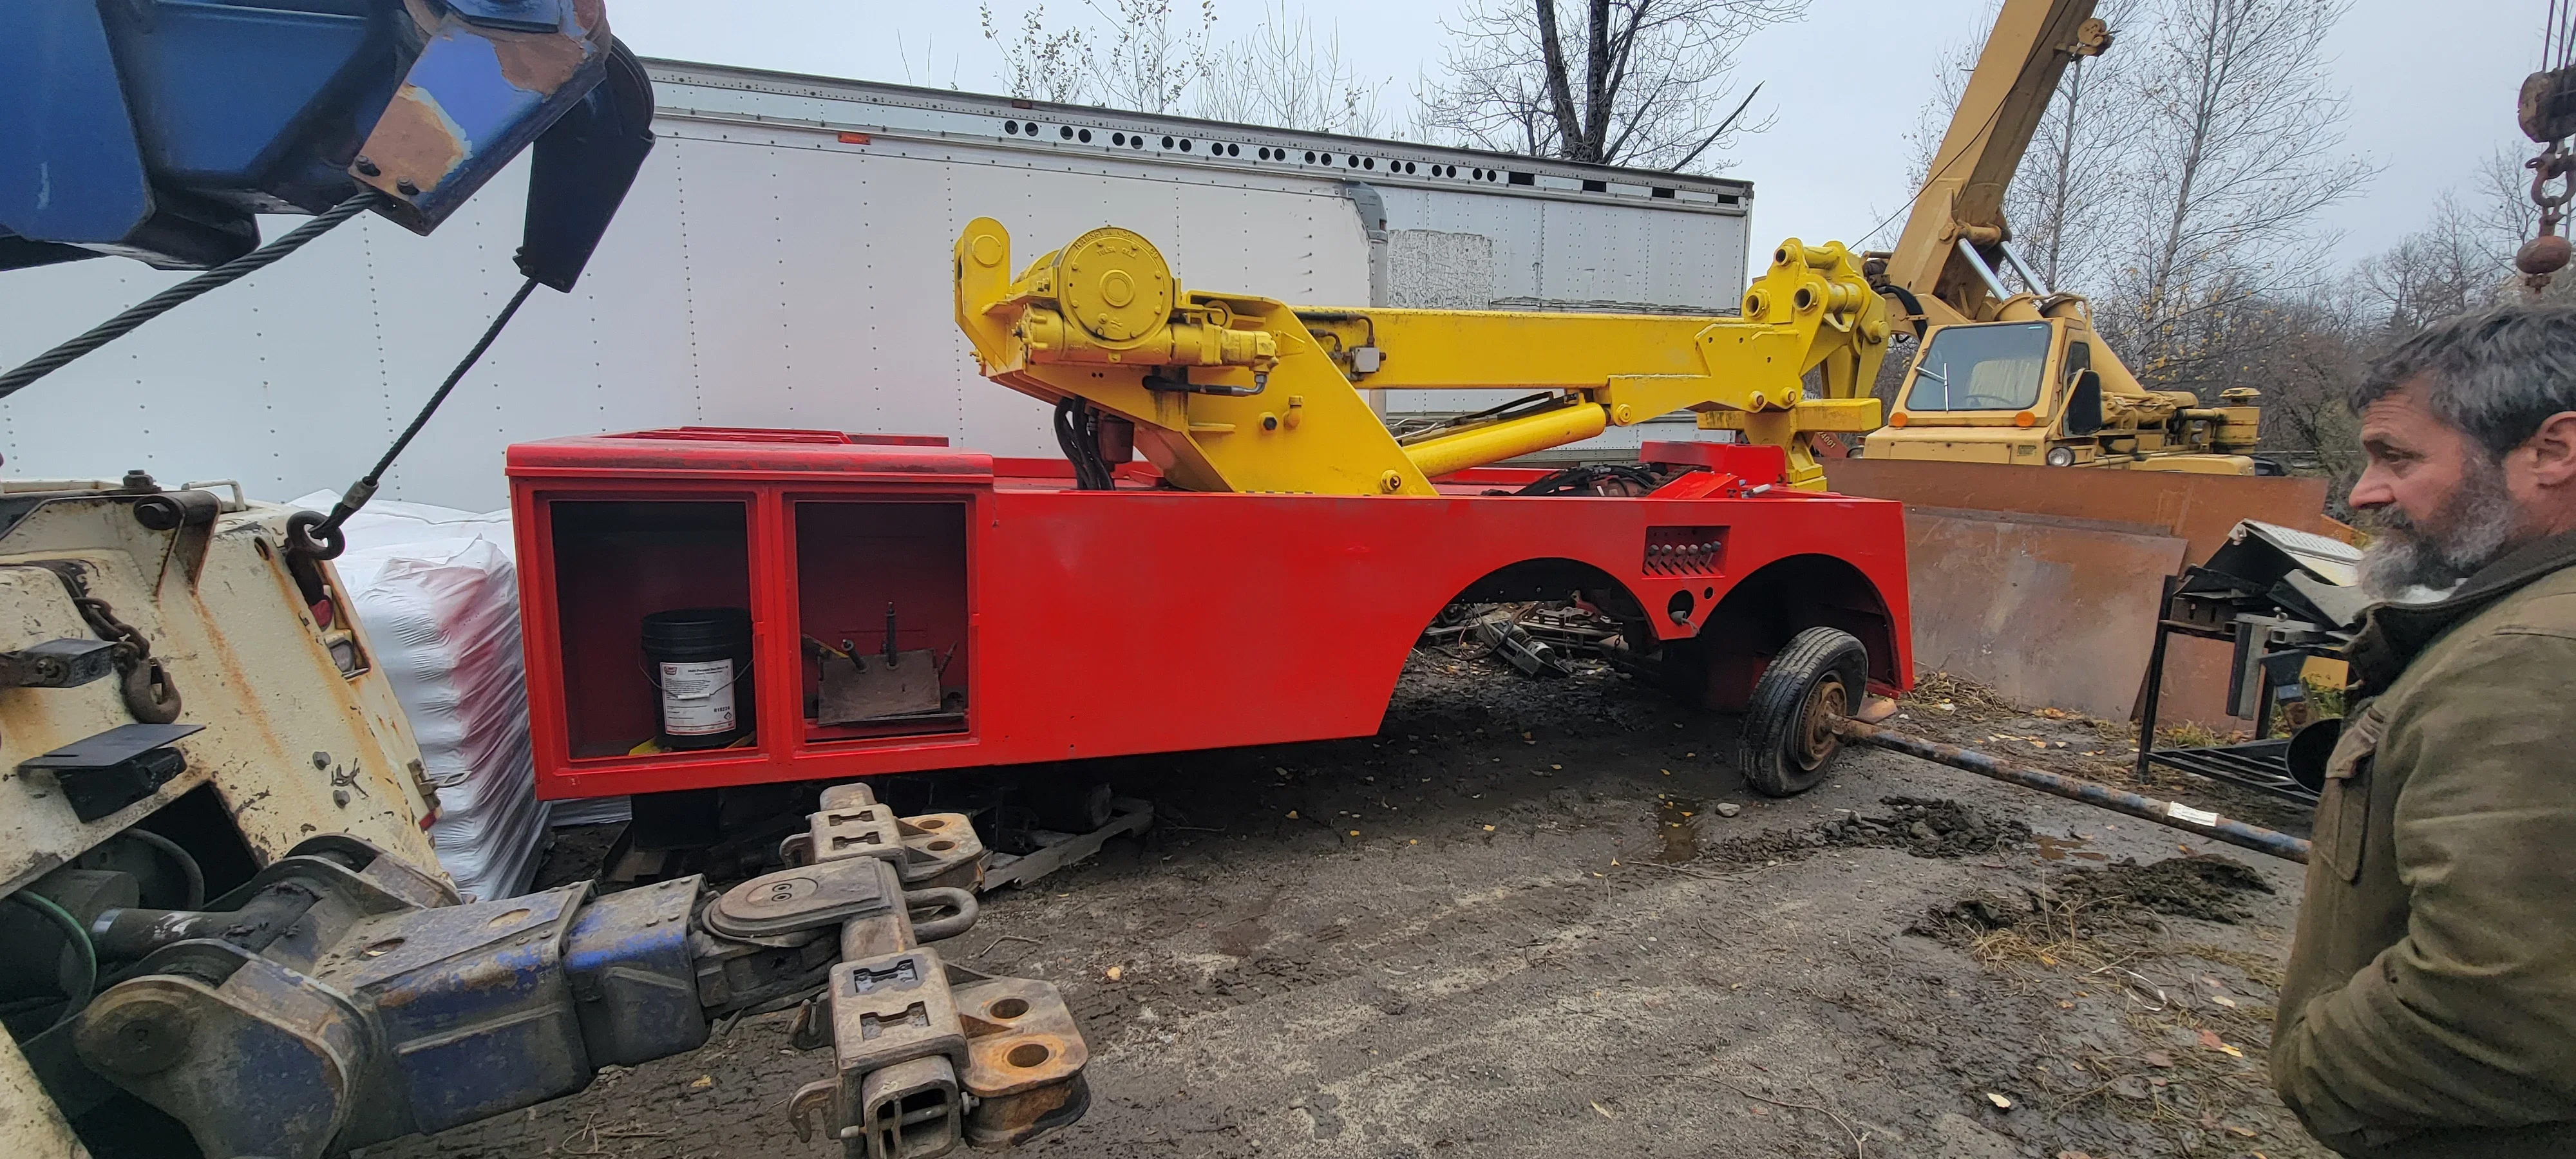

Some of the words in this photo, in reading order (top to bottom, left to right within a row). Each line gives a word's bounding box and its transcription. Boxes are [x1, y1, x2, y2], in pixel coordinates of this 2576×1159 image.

[1073, 229, 1103, 250] RAMSEY
[1149, 247, 1159, 259] CO
[1097, 246, 1116, 257] TULSA
